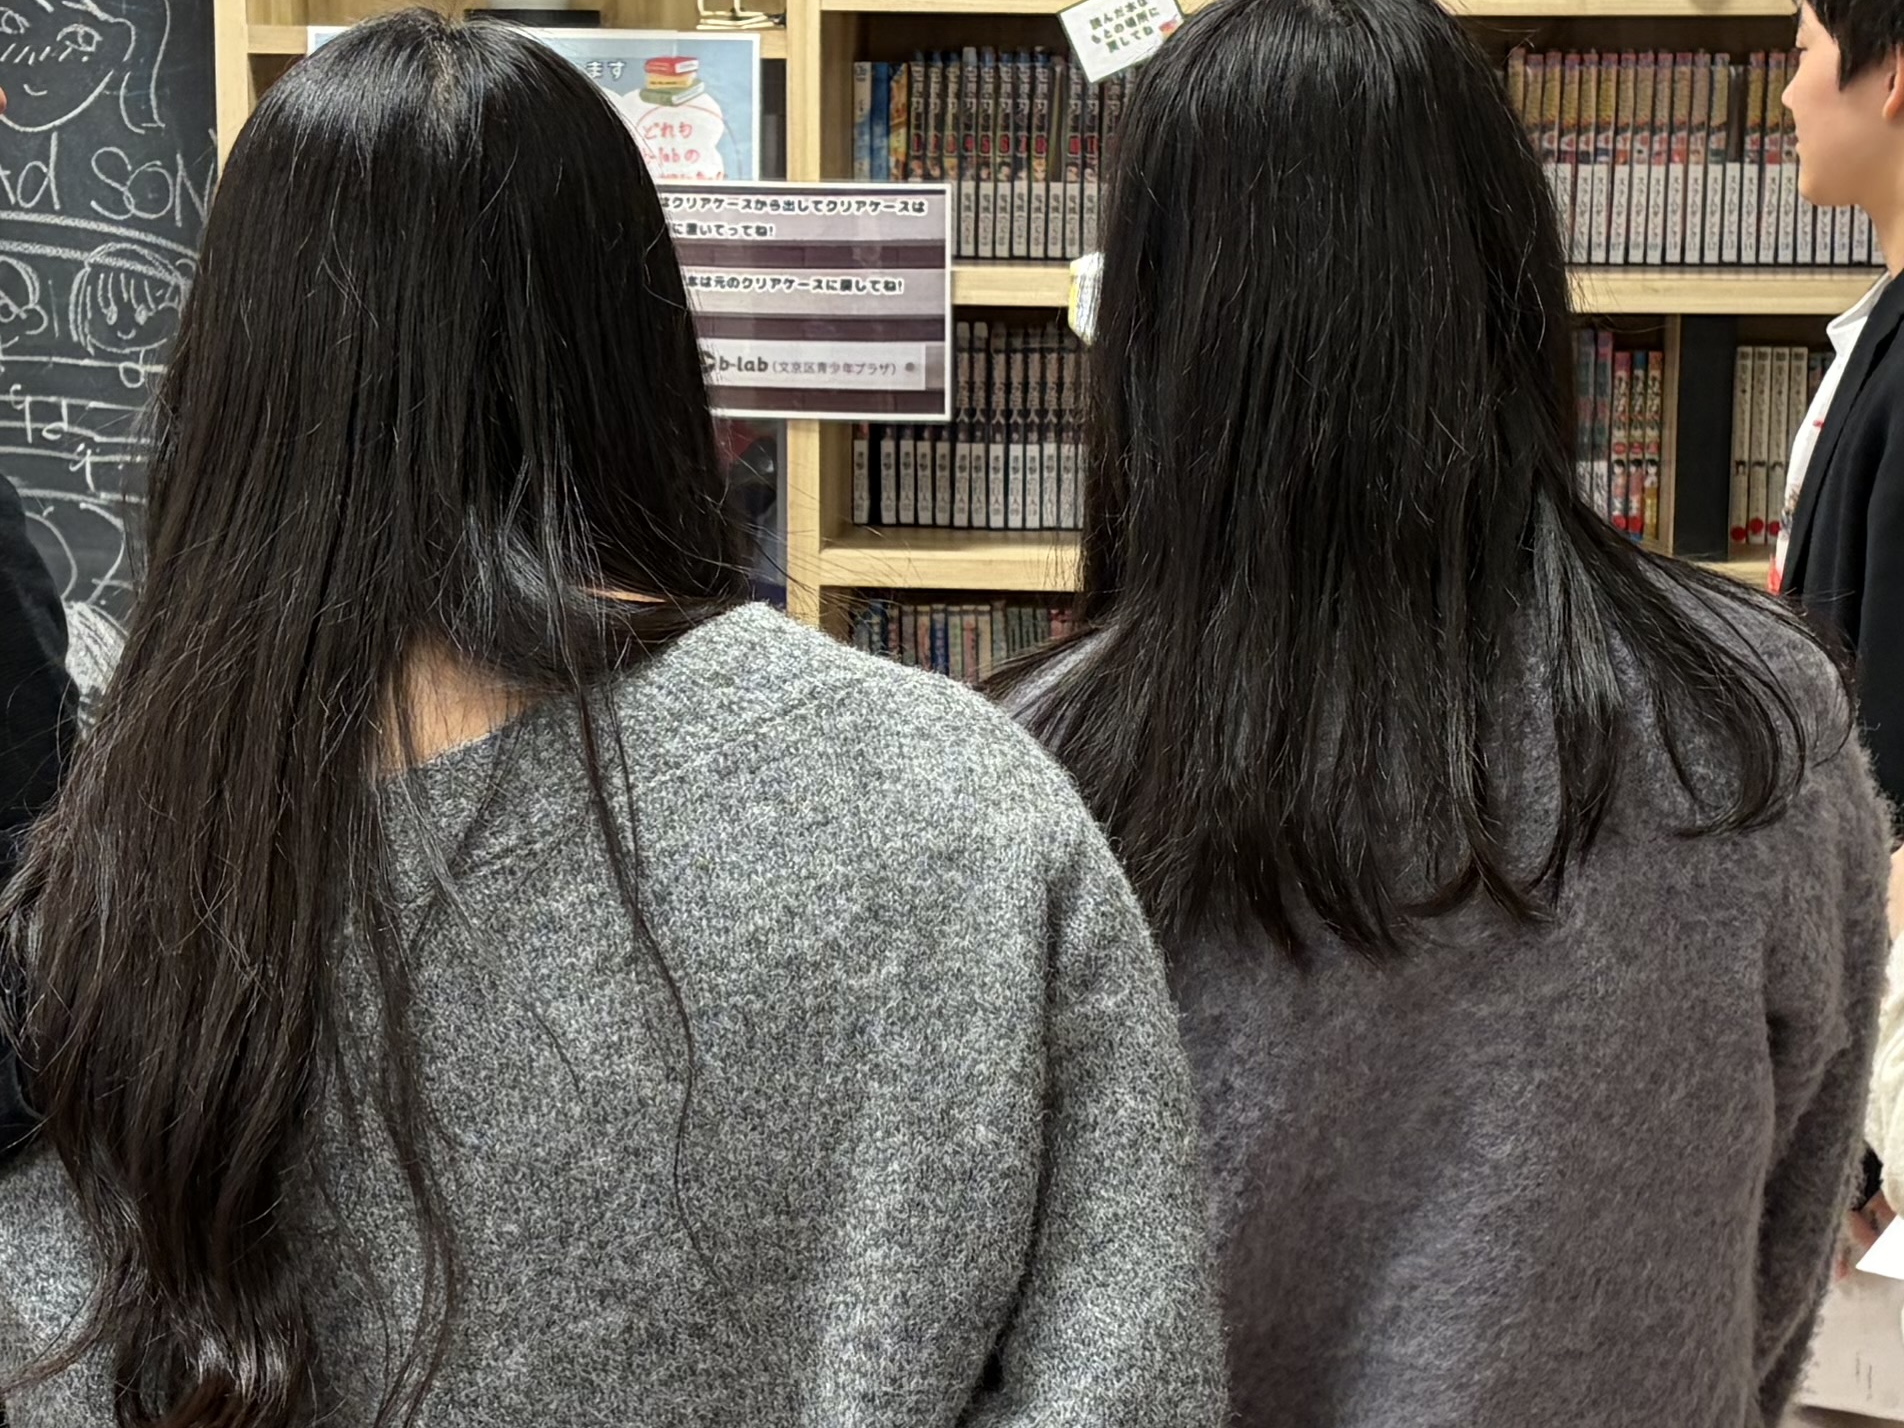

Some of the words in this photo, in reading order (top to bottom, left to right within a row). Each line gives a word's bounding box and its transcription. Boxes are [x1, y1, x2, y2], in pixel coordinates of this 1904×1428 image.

[645, 122, 693, 140] どれも
[718, 355, 769, 373] b-lab
[772, 359, 896, 375] （文京区青少年プラザ）
